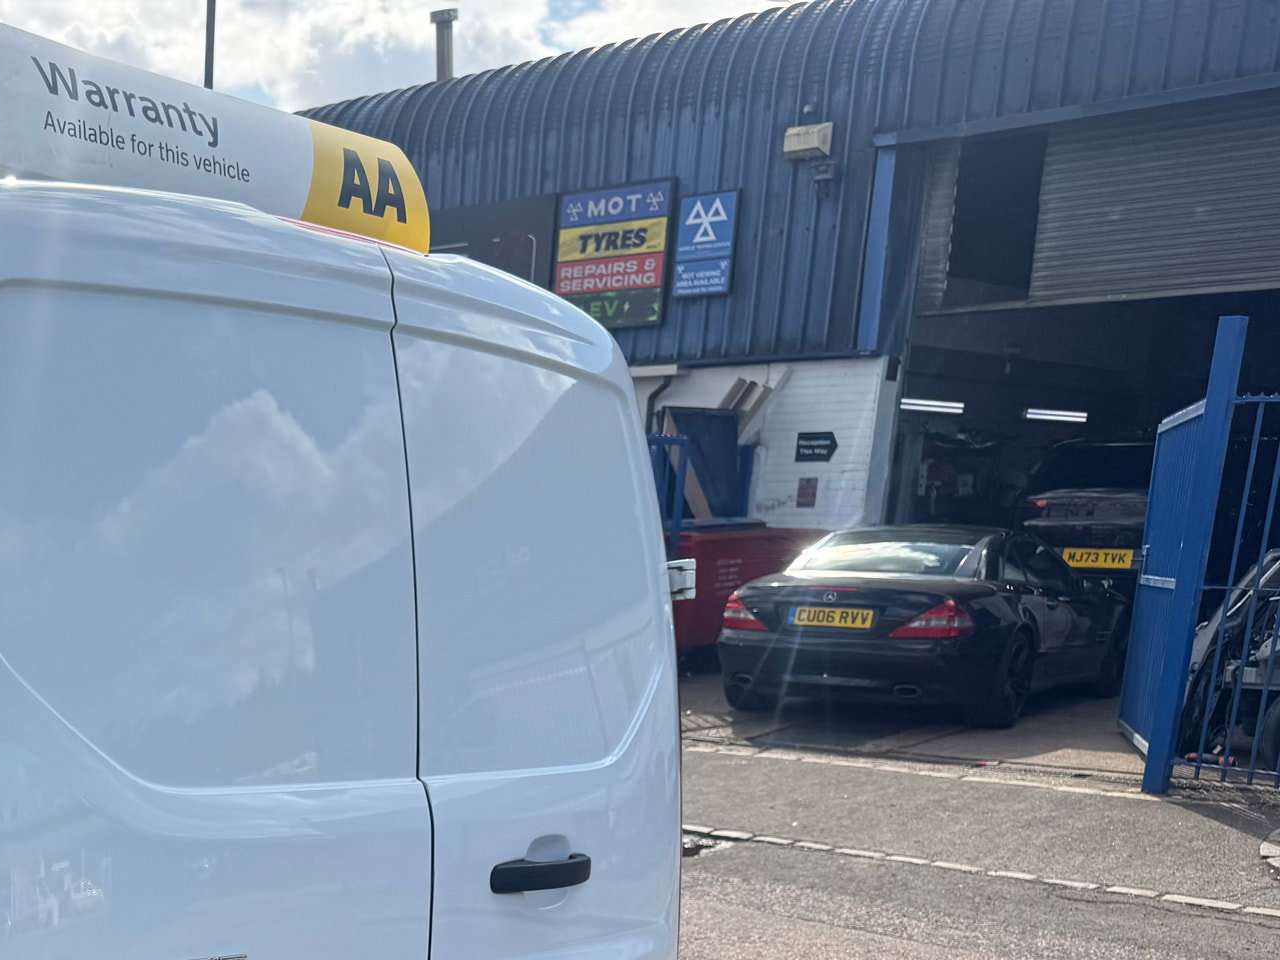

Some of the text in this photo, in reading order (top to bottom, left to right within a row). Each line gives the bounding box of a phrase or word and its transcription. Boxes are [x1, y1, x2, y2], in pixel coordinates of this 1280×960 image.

[30, 55, 219, 148] Warranty
[43, 110, 251, 183] Available for this vehicle
[337, 147, 407, 224] AA
[587, 194, 642, 218] MOT
[578, 228, 648, 254] TYRES
[560, 258, 656, 279] REPAIRS &
[560, 273, 656, 292] SERVICING
[590, 301, 618, 317] EV
[1103, 552, 1128, 564] TVK
